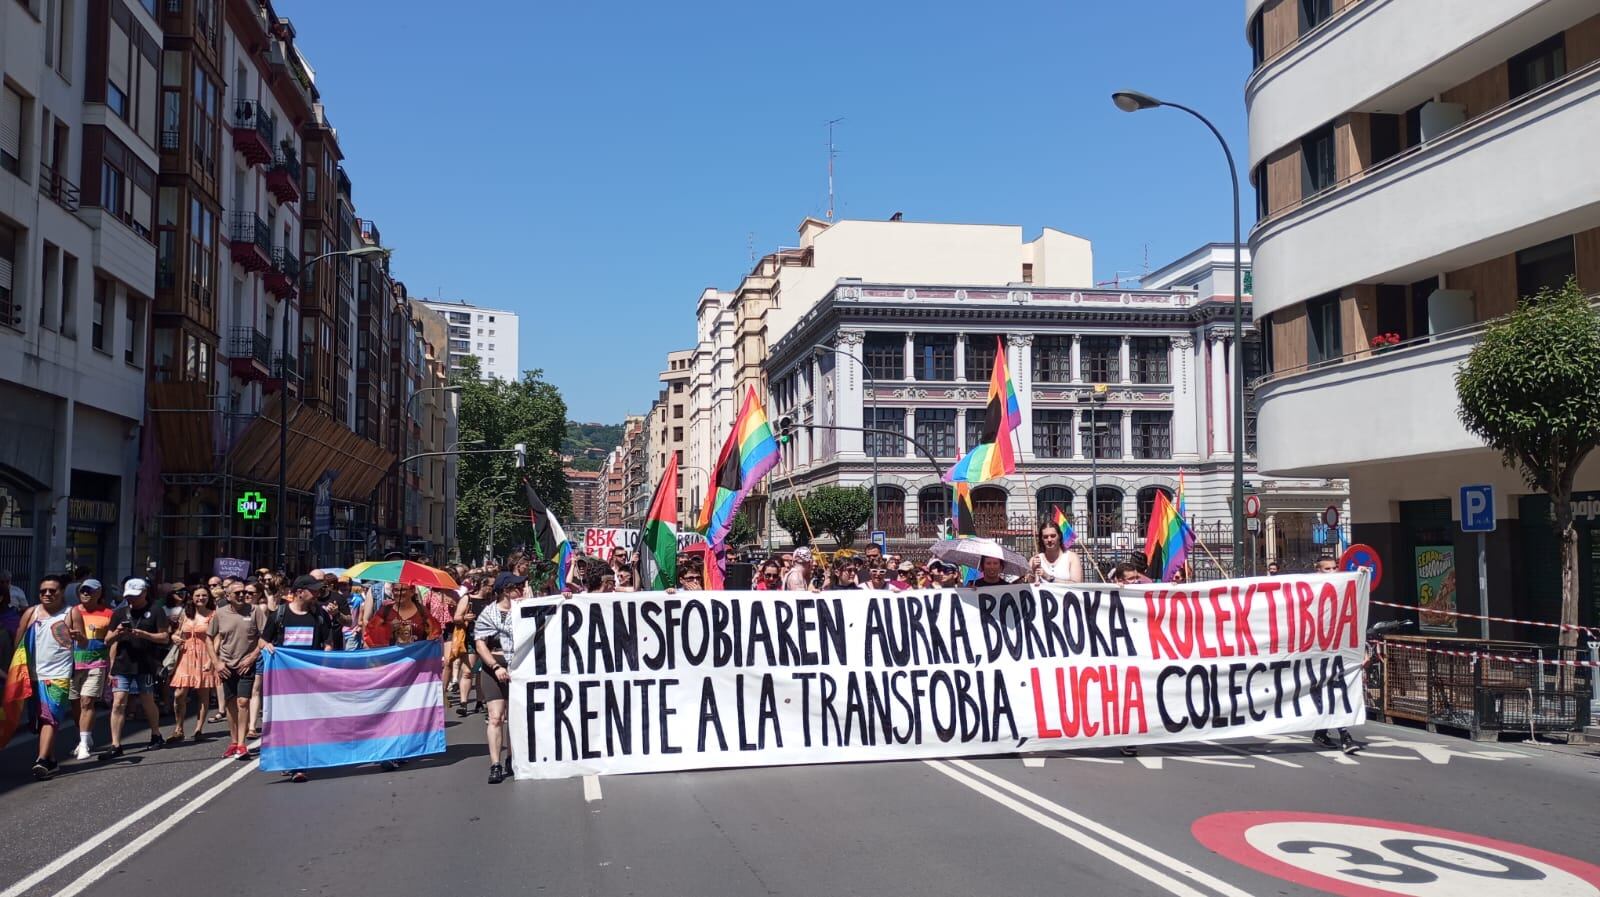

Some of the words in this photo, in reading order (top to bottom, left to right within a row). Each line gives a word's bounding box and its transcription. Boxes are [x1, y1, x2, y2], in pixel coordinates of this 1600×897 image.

[1466, 491, 1486, 526] P
[586, 529, 617, 548] BBK
[521, 599, 848, 675] TRANSFOBIAREN
[865, 593, 982, 667] AURKA,
[979, 589, 1137, 663] BORROKA
[1144, 579, 1358, 660] KOLEKTIBOA
[526, 679, 682, 762] FRENTE
[697, 676, 728, 752] A
[736, 673, 783, 751] LA
[792, 669, 1029, 748] TRANSFOBIA,
[1030, 664, 1148, 739] LUCHA
[1157, 655, 1352, 733] COLECTIVA
[1277, 838, 1547, 884] 30
